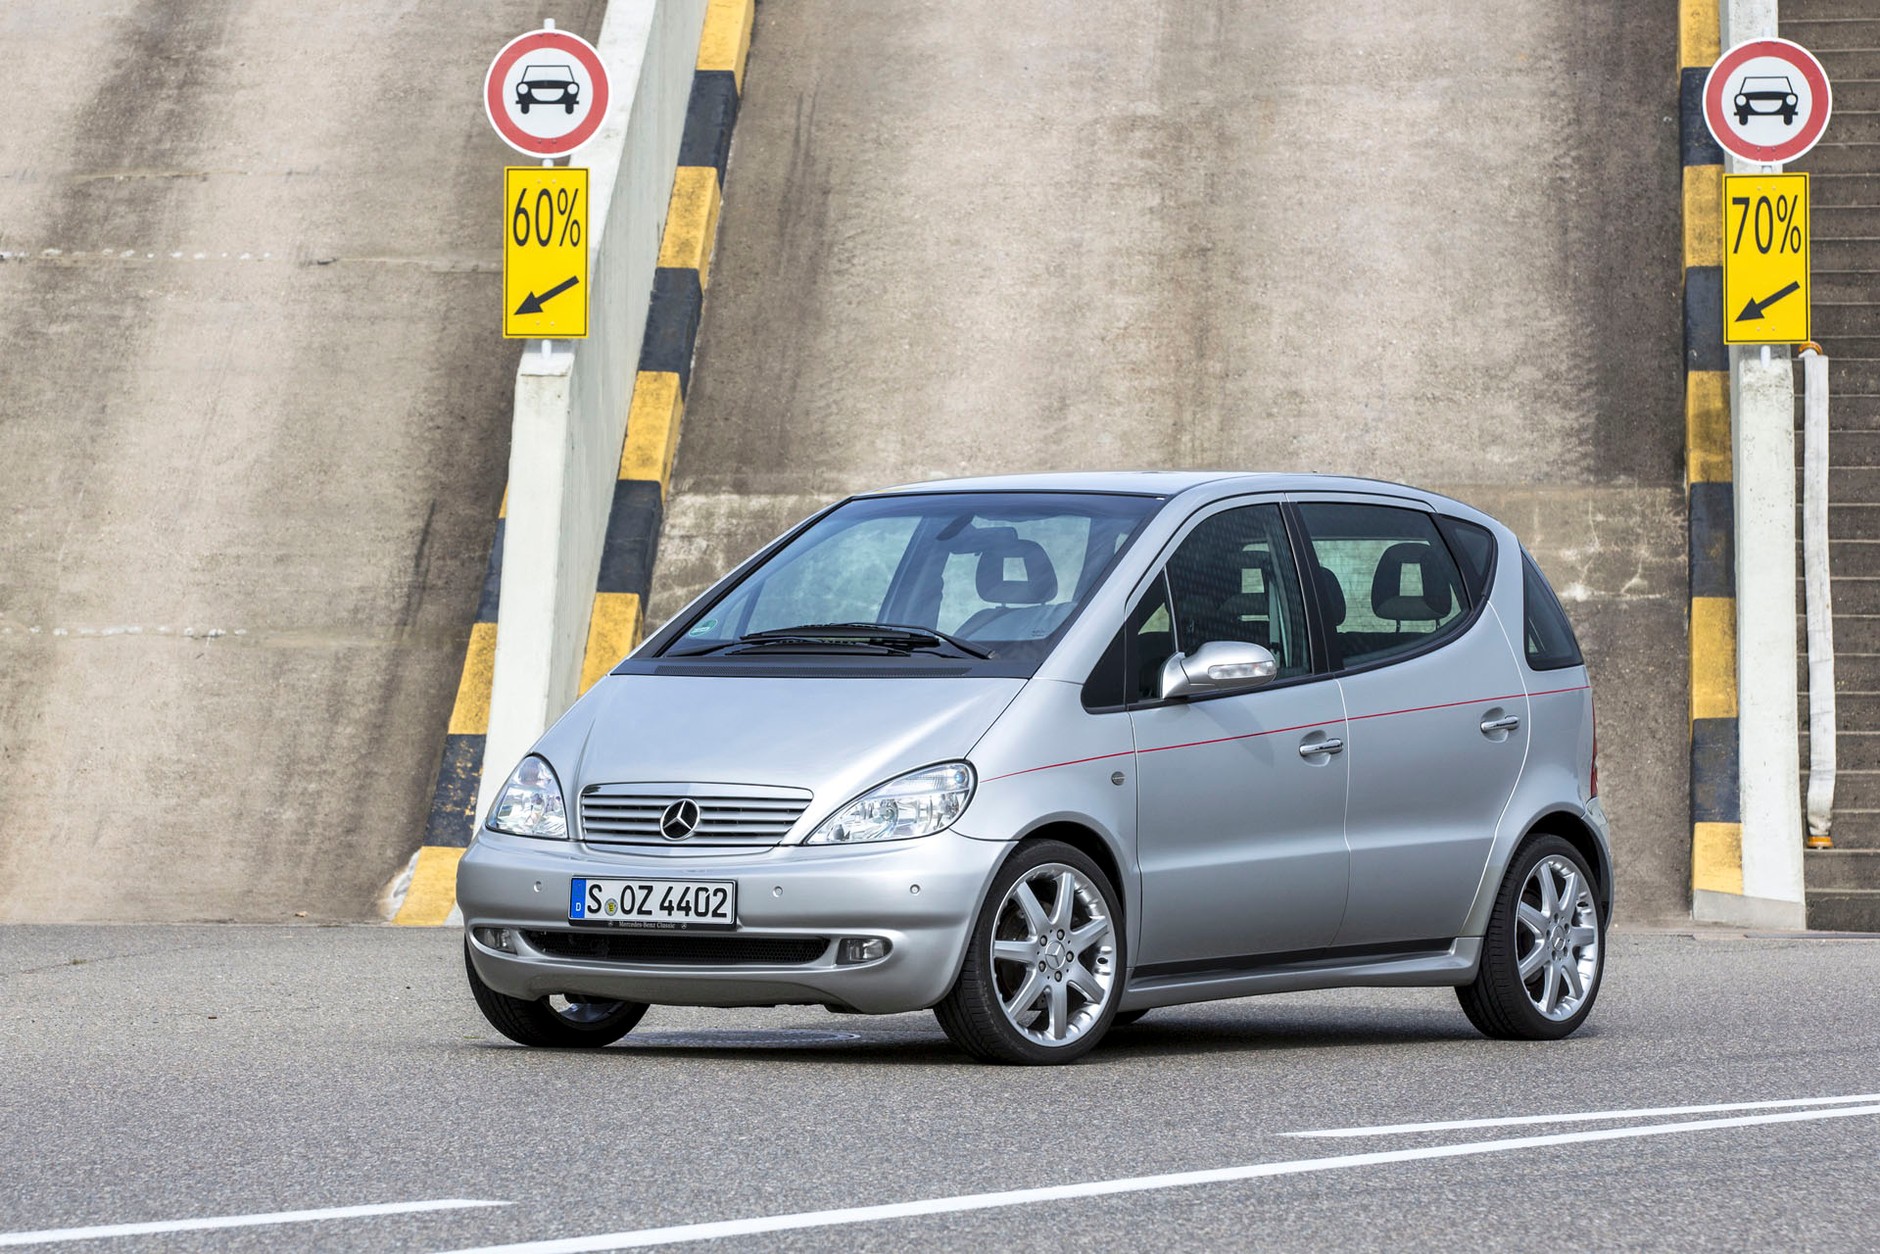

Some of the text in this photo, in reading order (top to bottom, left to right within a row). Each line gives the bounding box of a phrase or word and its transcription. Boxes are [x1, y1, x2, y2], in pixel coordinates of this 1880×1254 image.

[513, 187, 581, 247] 60%
[1732, 194, 1801, 255] 70%
[575, 902, 582, 912] D
[587, 883, 728, 918] S OZ 4402
